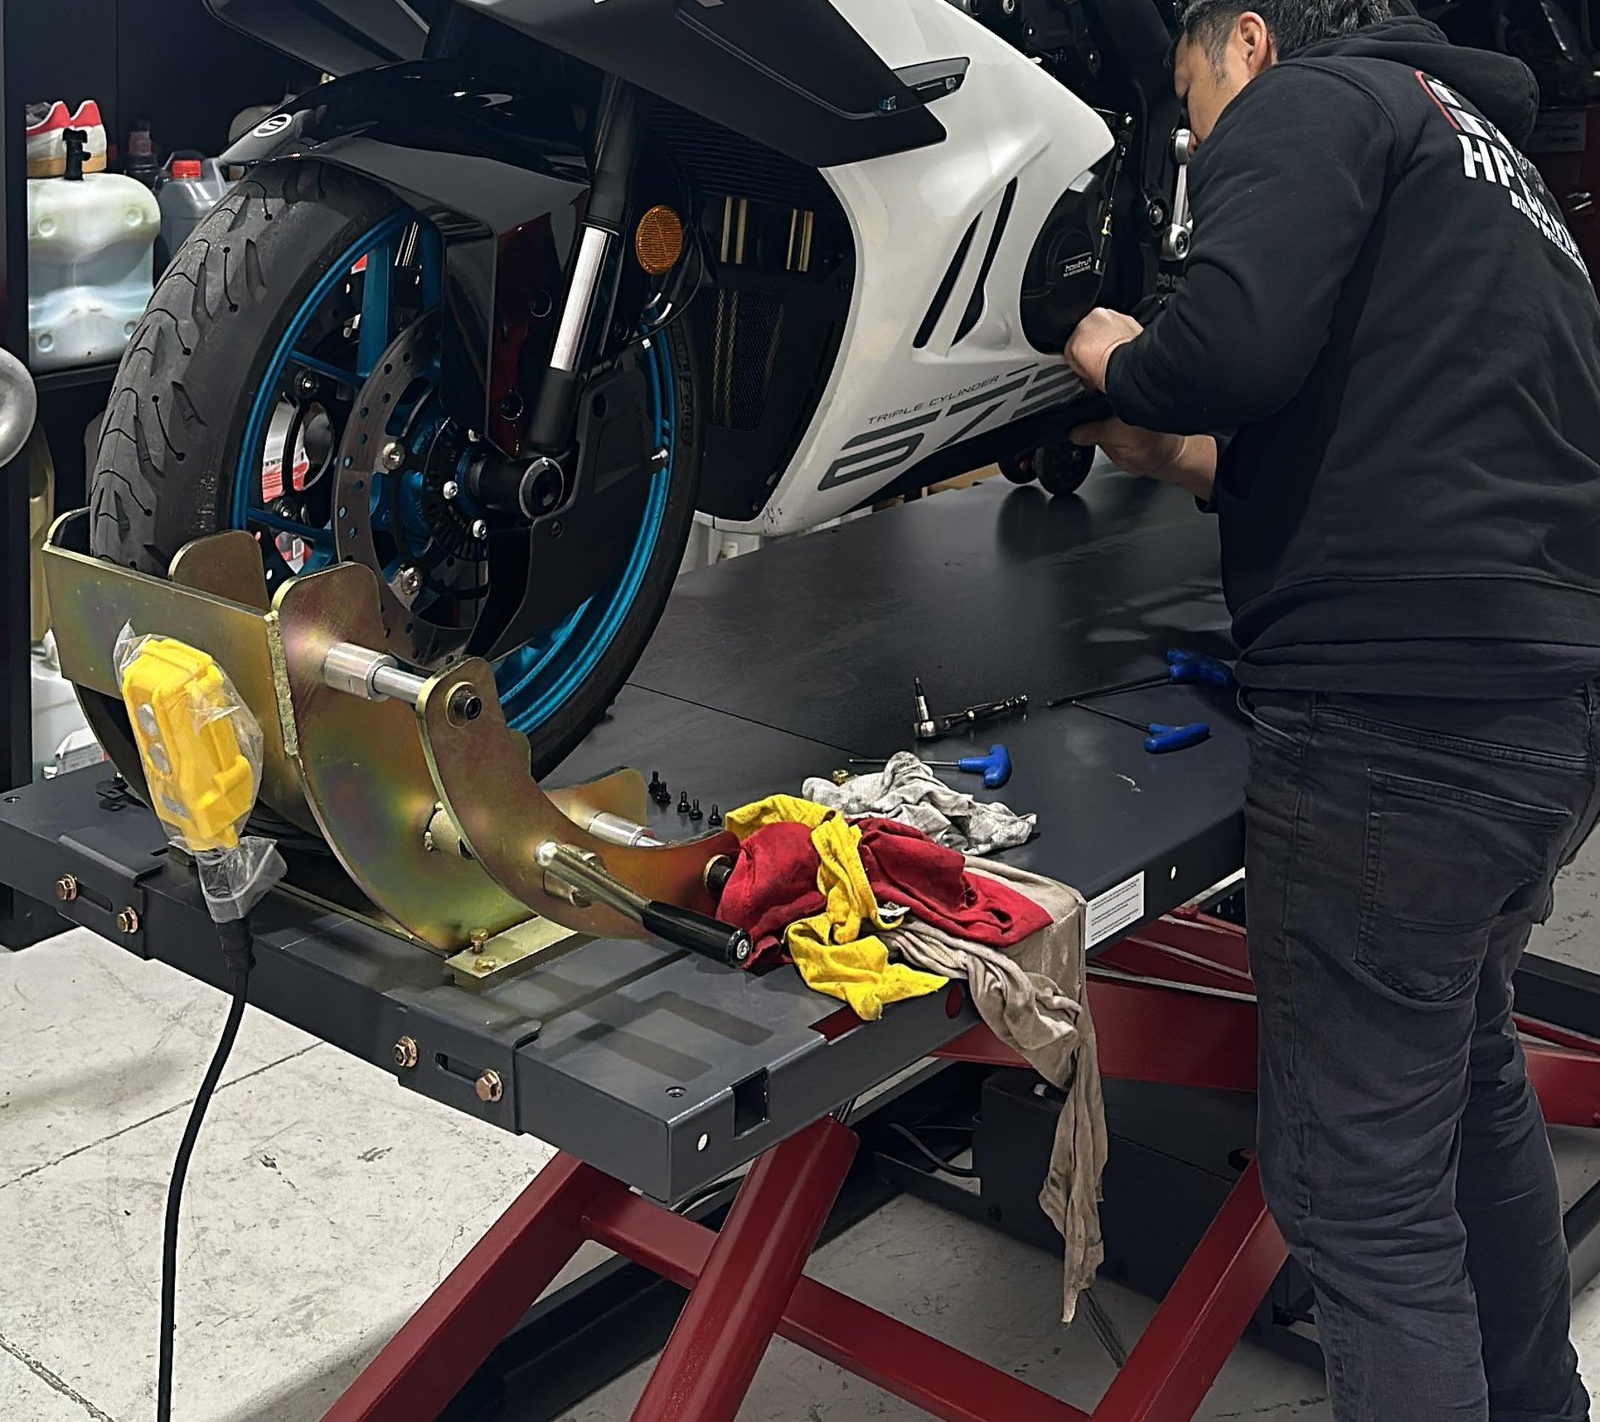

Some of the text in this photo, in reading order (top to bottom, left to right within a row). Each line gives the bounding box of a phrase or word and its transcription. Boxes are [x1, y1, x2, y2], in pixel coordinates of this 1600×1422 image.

[1456, 134, 1515, 188] HP
[868, 375, 1000, 425] TRIPLE CYLINDER
